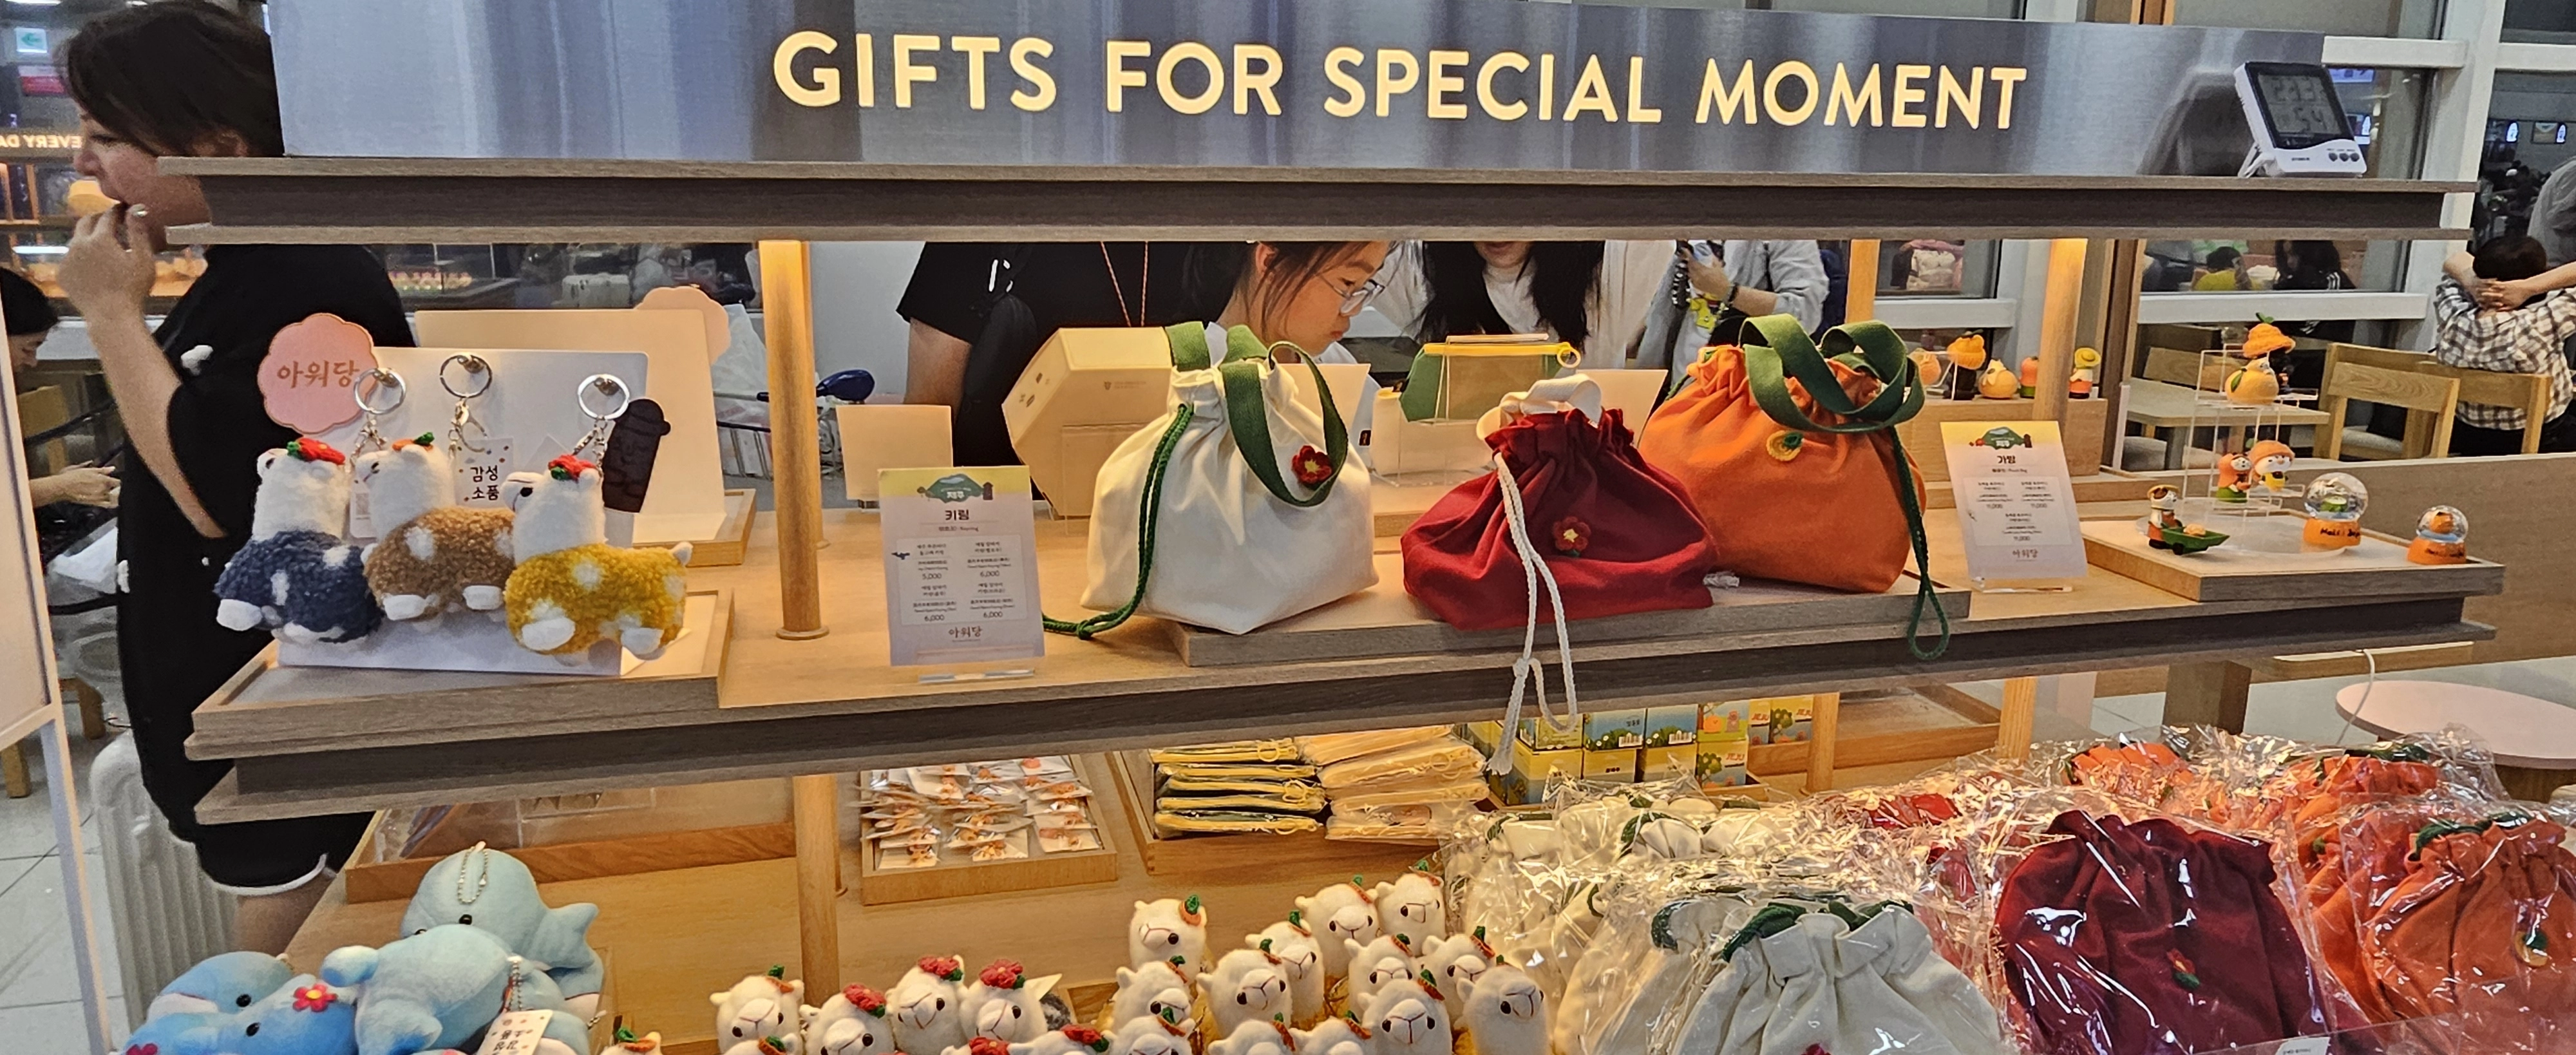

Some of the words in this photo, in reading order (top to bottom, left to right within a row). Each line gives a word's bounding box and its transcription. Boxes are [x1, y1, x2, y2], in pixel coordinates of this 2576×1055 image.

[773, 30, 1057, 111] GIFTS
[1106, 41, 1282, 116] FOR
[1323, 46, 1662, 123] SPECIAL
[1694, 57, 2027, 129] MOMENT
[276, 359, 361, 389] 아워당
[1996, 455, 2016, 464] 가방
[470, 465, 498, 483] 감성
[471, 484, 500, 501] 소품
[944, 509, 970, 521] 키링
[924, 613, 945, 622] 6,000
[983, 611, 1003, 619] 6,000
[948, 625, 983, 639] 아워당
